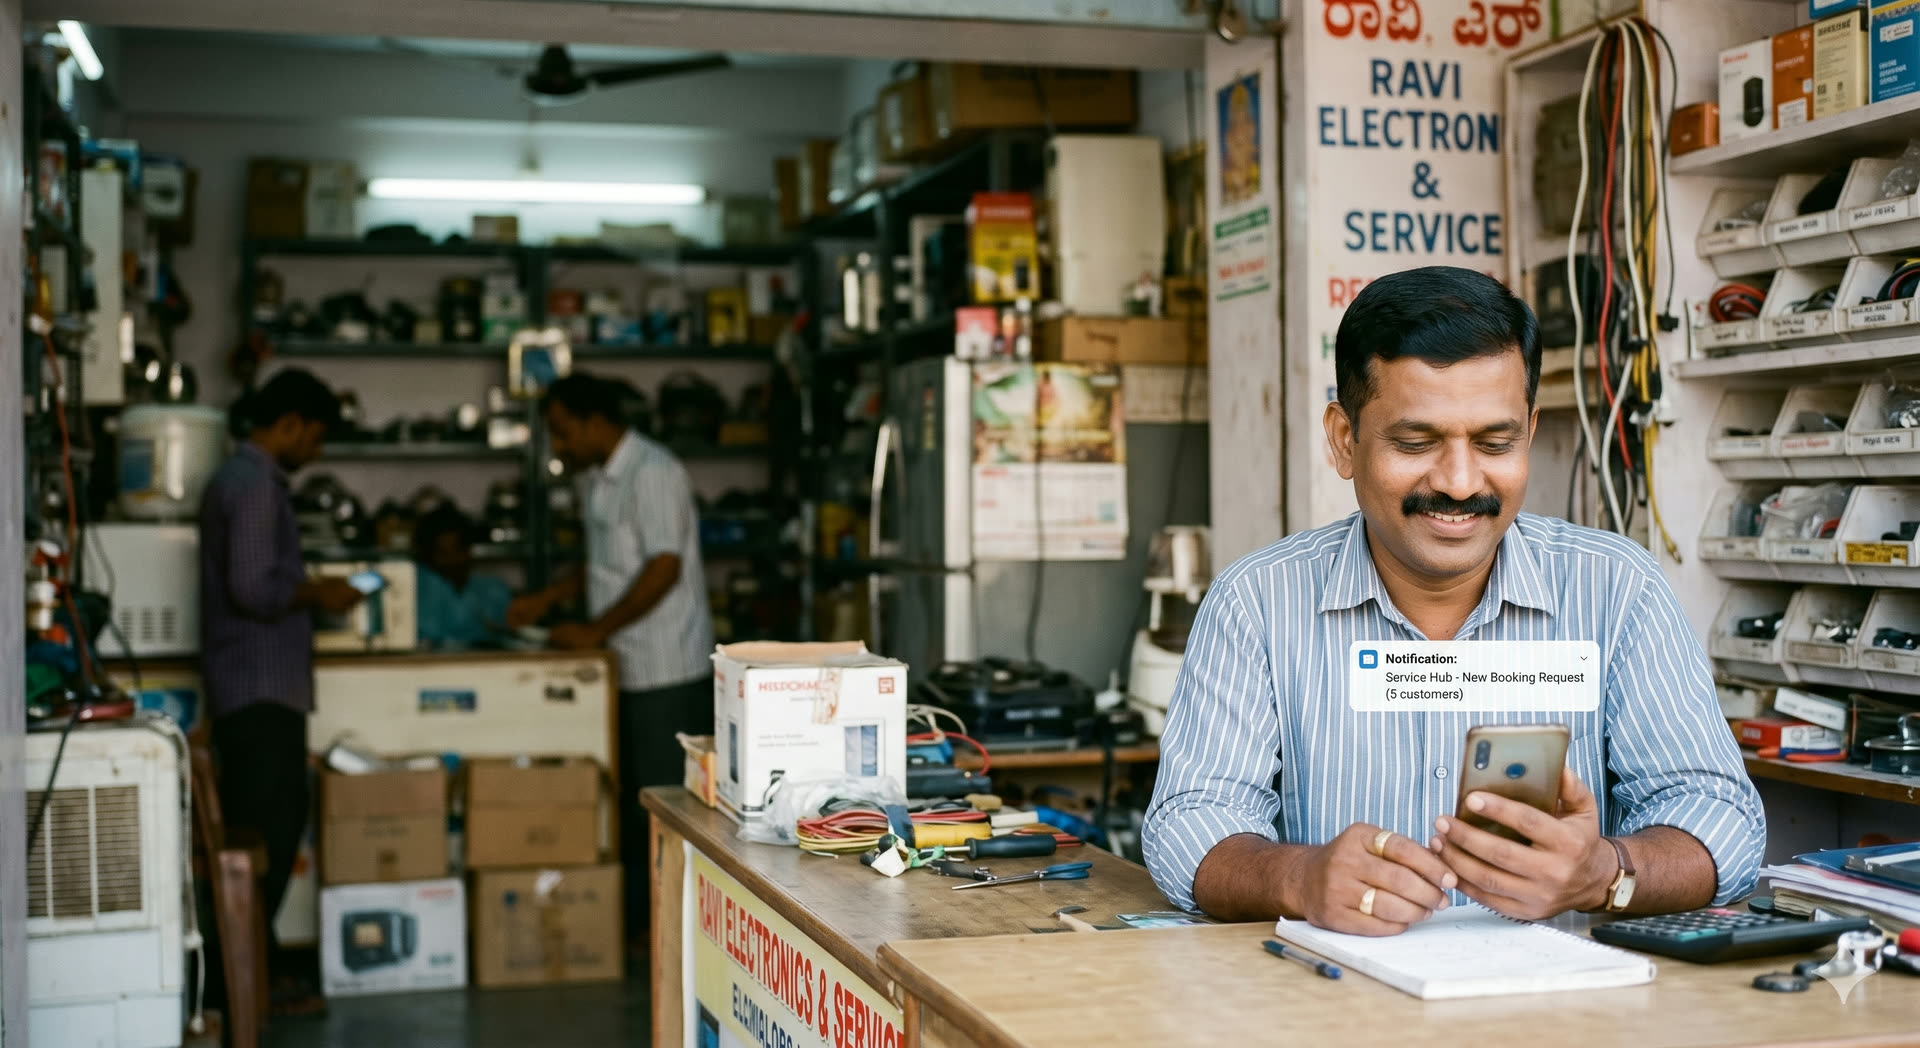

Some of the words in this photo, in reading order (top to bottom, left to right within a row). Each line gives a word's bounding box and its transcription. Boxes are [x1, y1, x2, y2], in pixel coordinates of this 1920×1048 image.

[1371, 59, 1461, 99] RAVI
[1319, 106, 1499, 153] ELECTRON
[1411, 161, 1440, 199] &
[1345, 210, 1503, 255] SERVICE
[698, 872, 722, 946] RAVI
[725, 896, 813, 1026] ELECTRONICS
[818, 968, 829, 1040] &
[833, 981, 904, 1048] SERVI
